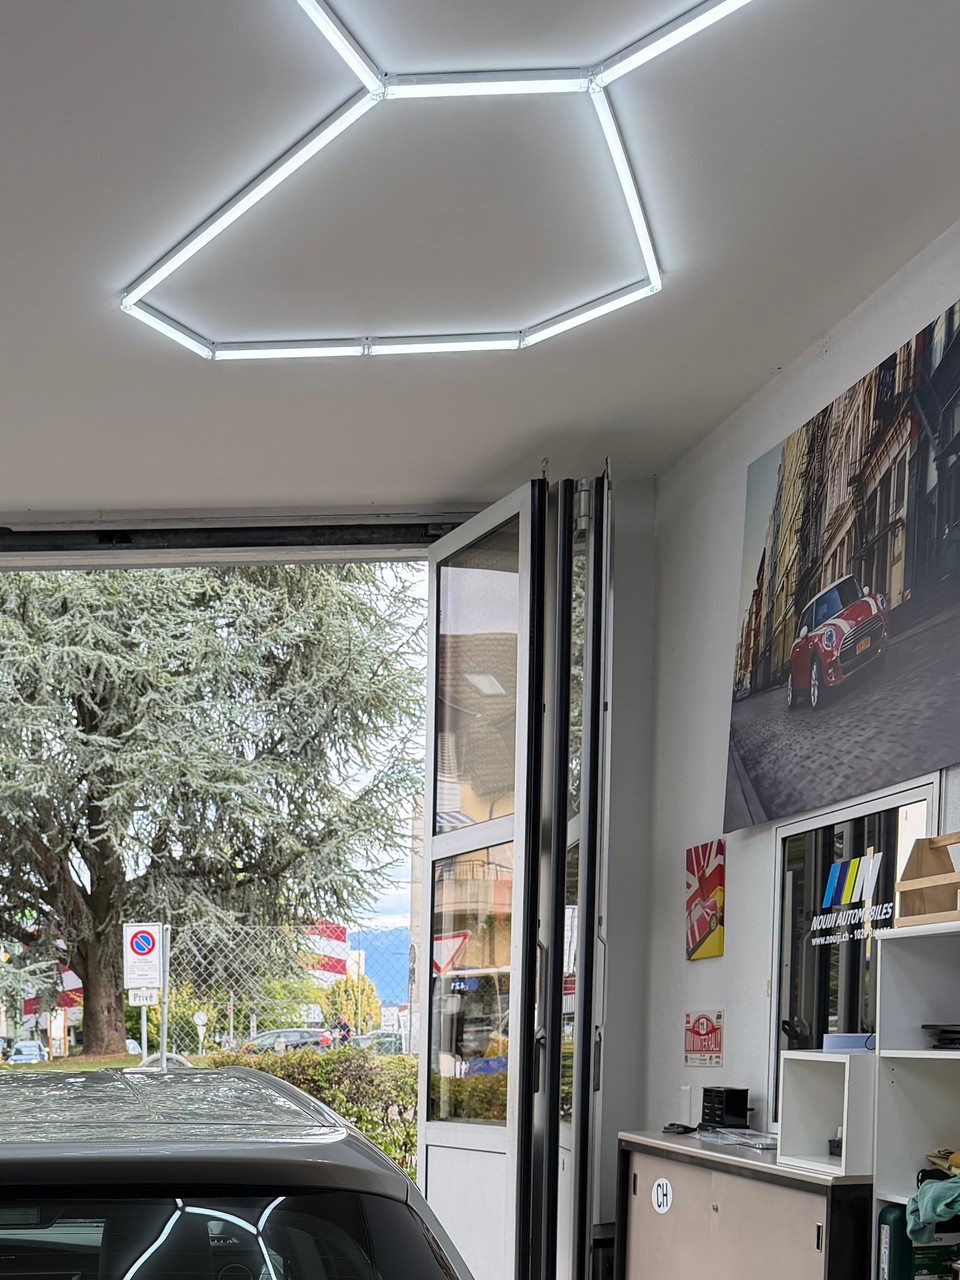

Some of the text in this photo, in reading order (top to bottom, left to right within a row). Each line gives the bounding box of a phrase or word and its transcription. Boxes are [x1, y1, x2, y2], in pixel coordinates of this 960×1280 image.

[810, 902, 894, 932] NOUIJI AUTOMOBILES
[656, 1182, 668, 1208] CH
